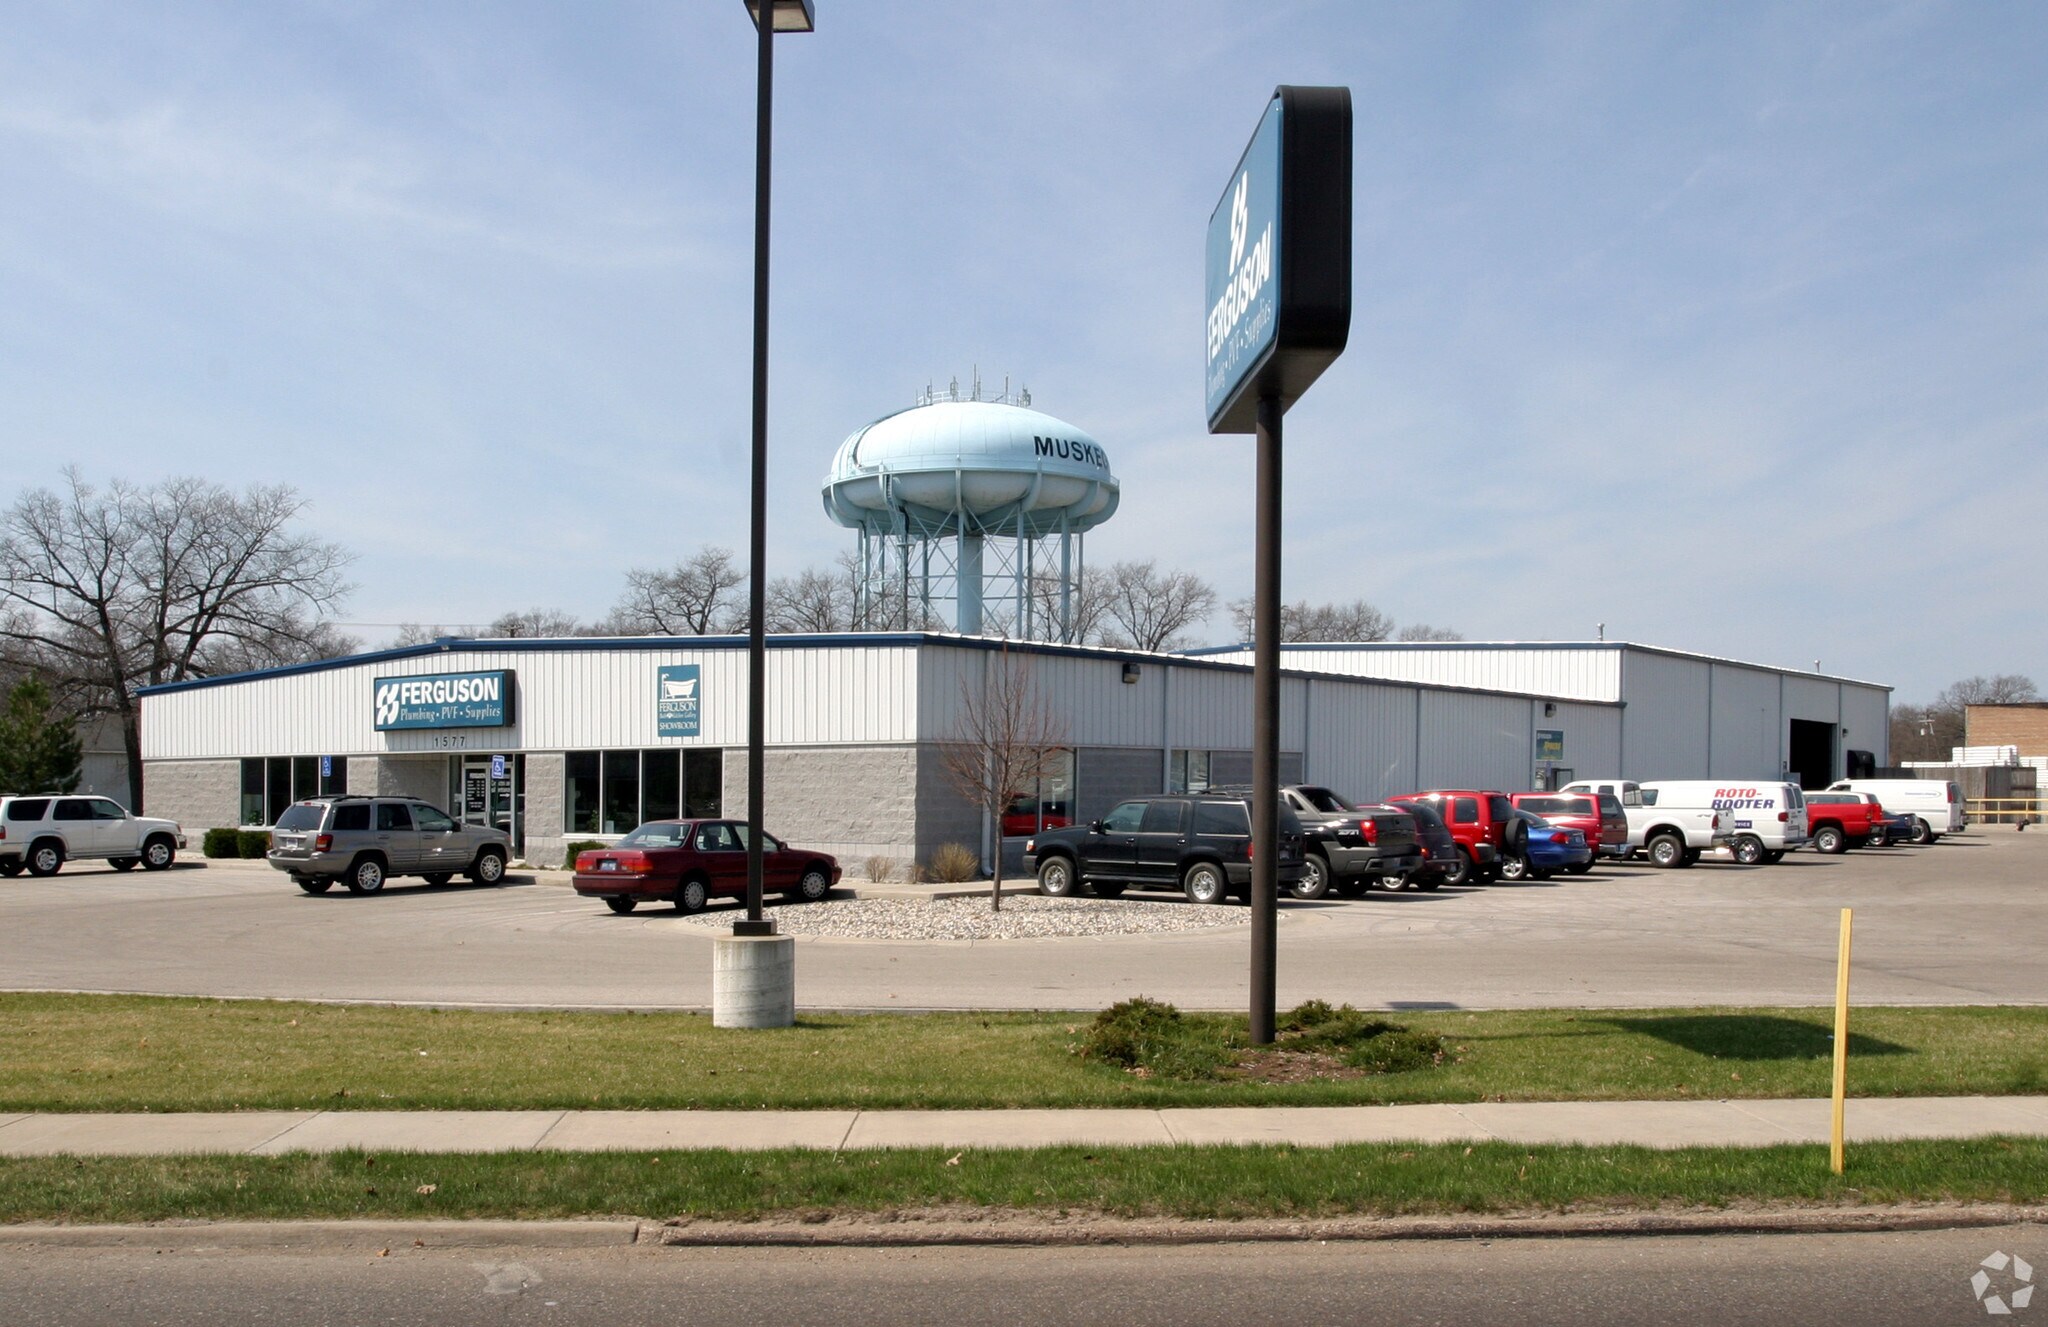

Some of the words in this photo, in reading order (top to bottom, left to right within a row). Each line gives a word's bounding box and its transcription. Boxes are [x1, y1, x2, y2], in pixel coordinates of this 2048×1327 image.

[1207, 221, 1271, 368] FERGUSON
[401, 677, 498, 705] FERGUSON
[659, 701, 697, 711] FERGUSON
[465, 704, 500, 720] Supplies
[659, 721, 698, 730] SHOWROOM
[434, 736, 465, 747] 1577
[1714, 788, 1762, 798] ROTO-
[1711, 799, 1775, 809] ROOTER
